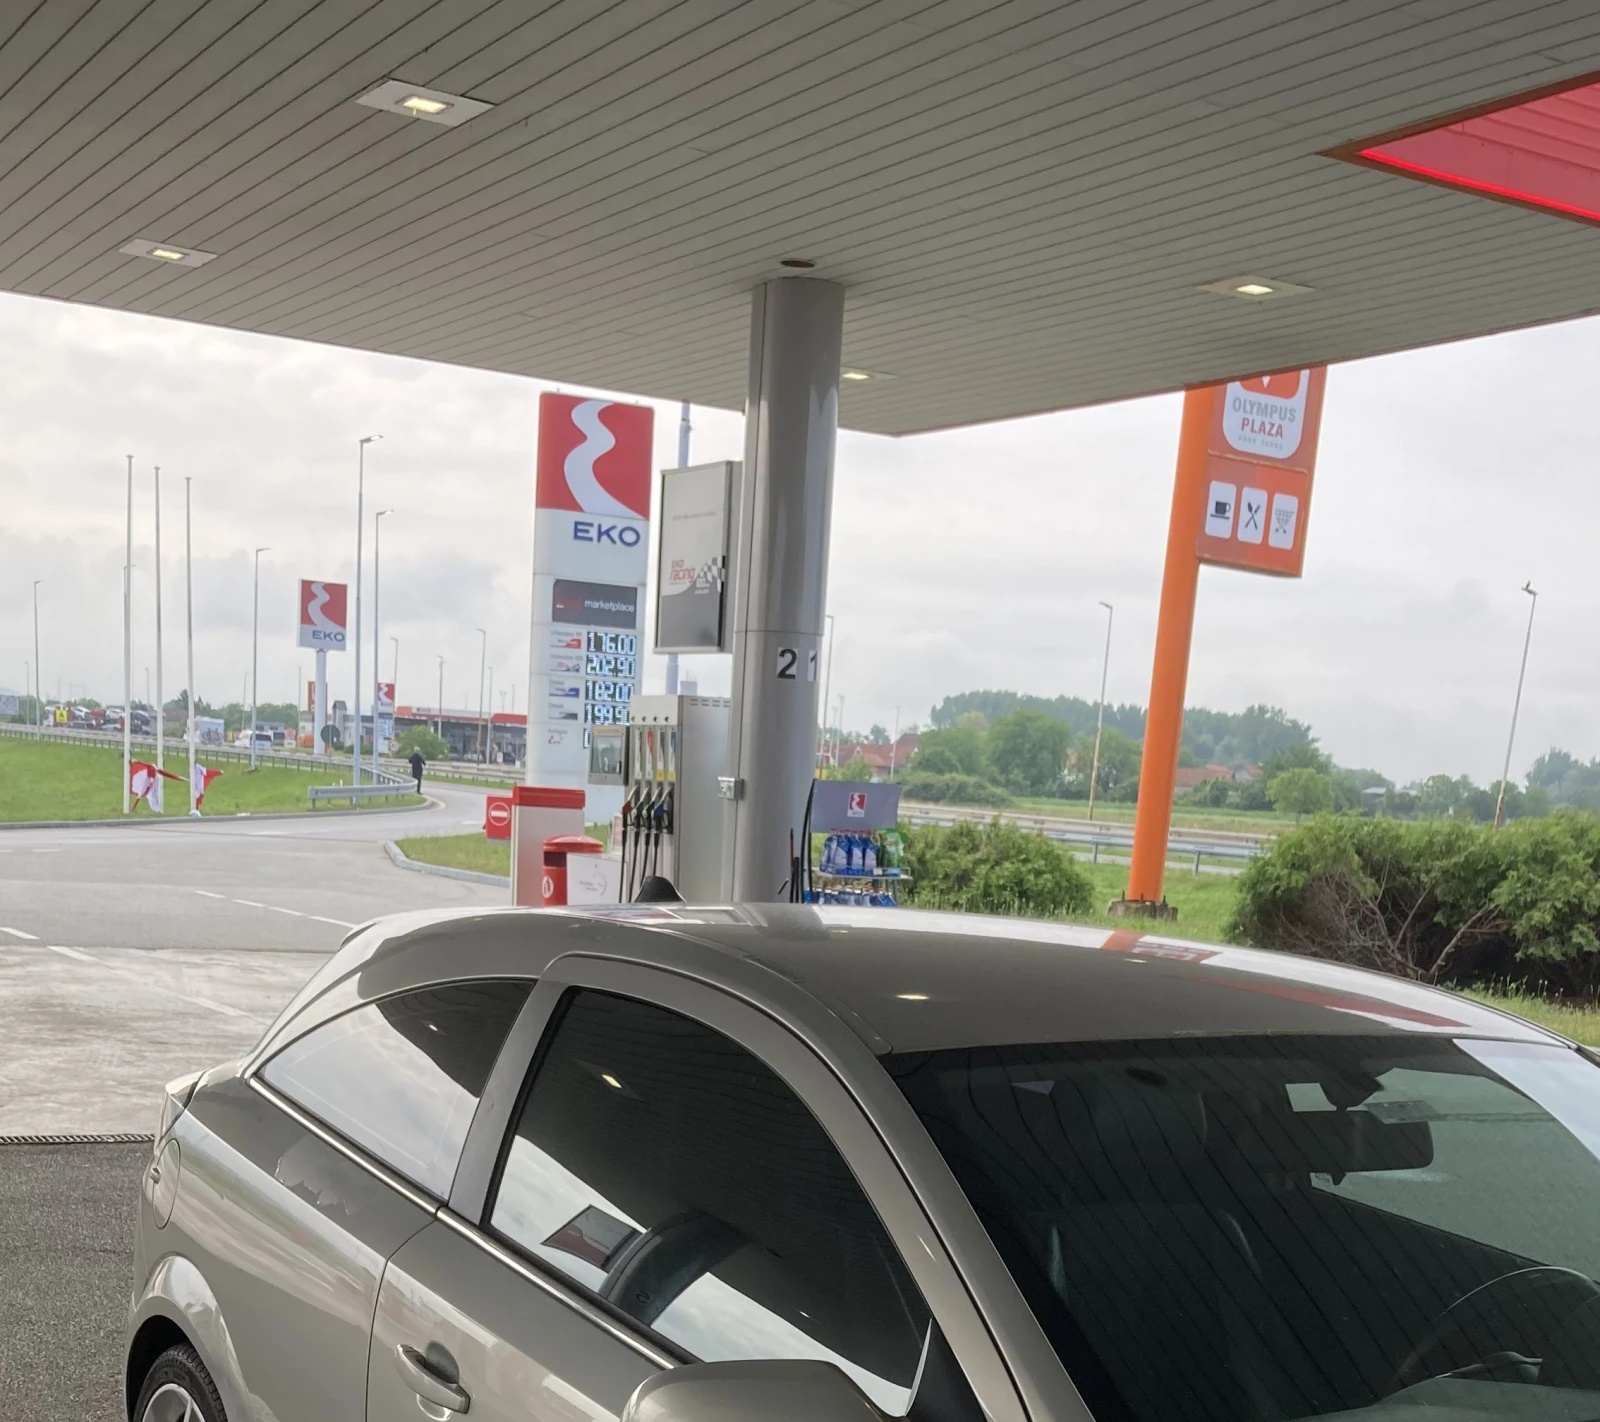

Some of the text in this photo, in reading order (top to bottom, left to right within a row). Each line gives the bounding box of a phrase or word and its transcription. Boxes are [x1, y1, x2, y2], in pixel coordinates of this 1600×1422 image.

[1232, 396, 1297, 423] OLYMPUS
[1240, 417, 1284, 439] PLAZA
[573, 520, 641, 547] EKO
[584, 599, 635, 613] marketplace
[312, 629, 345, 642] EKO
[777, 648, 797, 680] 2
[810, 651, 818, 681] 1
